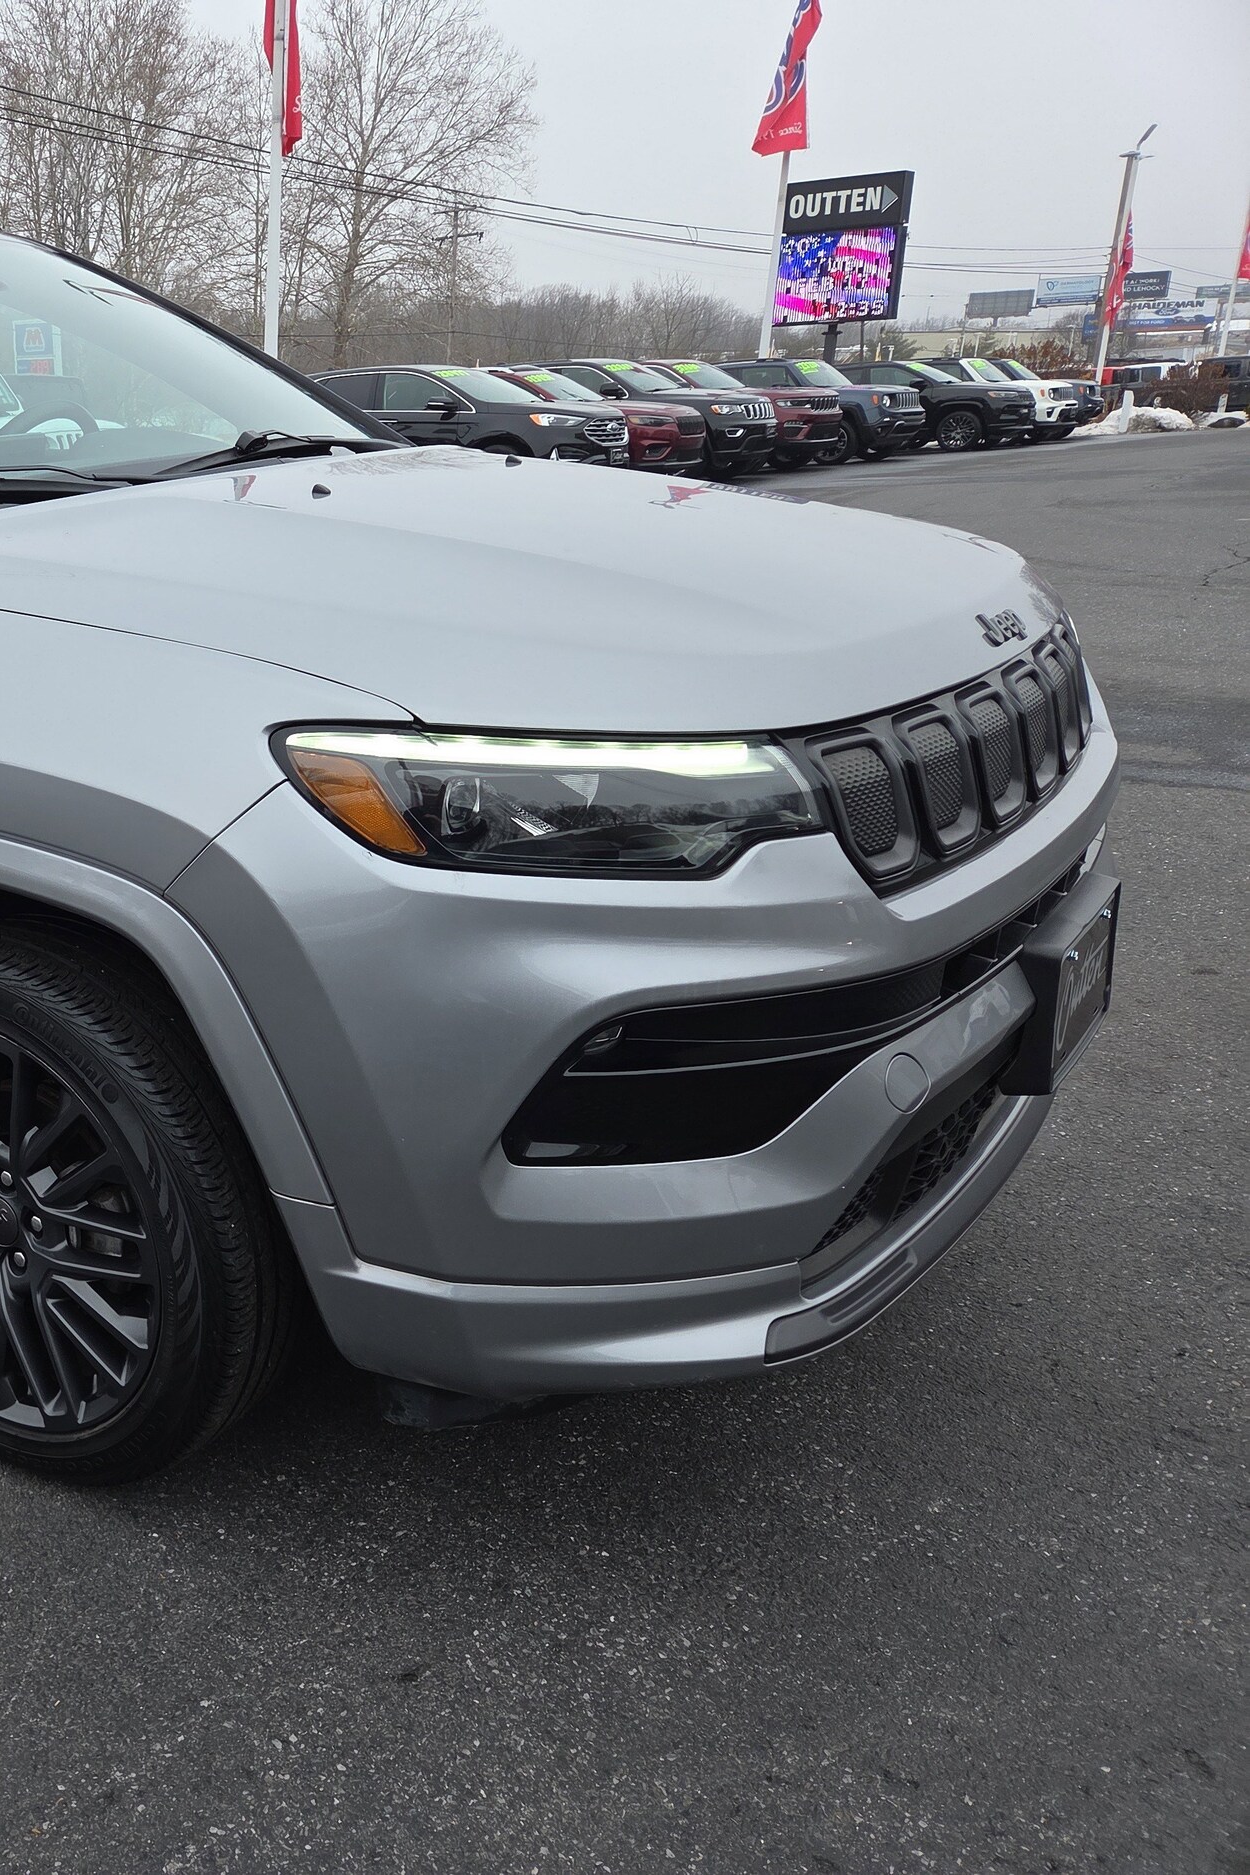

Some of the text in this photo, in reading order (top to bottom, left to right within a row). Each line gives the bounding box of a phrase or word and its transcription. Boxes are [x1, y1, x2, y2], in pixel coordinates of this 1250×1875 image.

[789, 185, 882, 219] OUTTEN
[1133, 284, 1165, 292] LEHOCKY
[974, 609, 1028, 648] Jeep
[1056, 934, 1109, 1051] Outten
